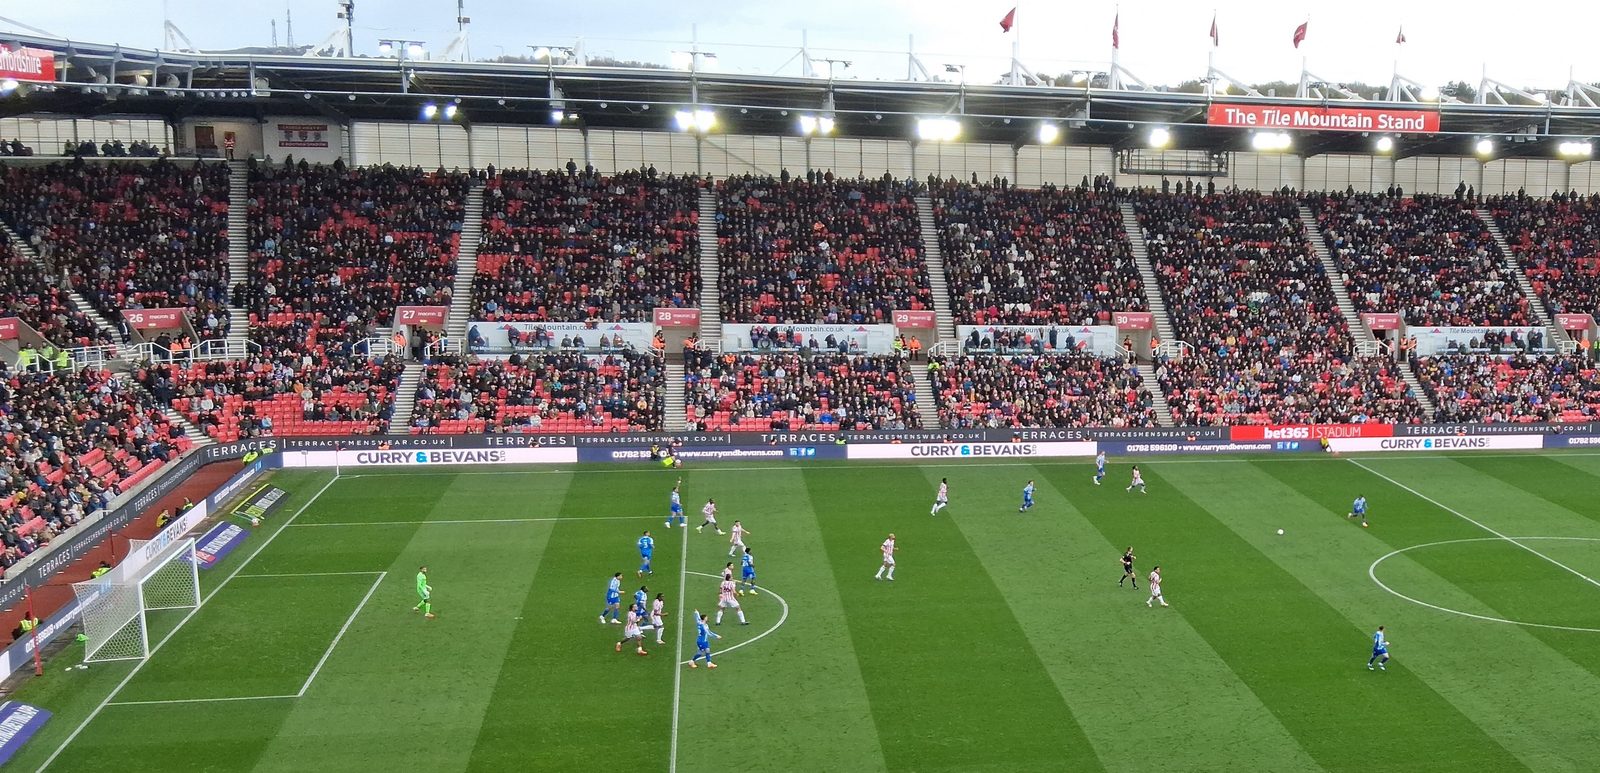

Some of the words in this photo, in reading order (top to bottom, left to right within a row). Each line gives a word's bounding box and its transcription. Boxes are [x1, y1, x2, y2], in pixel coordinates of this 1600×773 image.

[1225, 108, 1257, 124] The
[1262, 109, 1291, 125] Tile
[1294, 110, 1373, 128] Mountain
[1377, 113, 1425, 130] Stand
[129, 313, 144, 323] 26
[402, 310, 416, 319] 27
[659, 311, 672, 321] 28
[897, 314, 909, 323] 29
[1117, 316, 1128, 324] 30
[1367, 316, 1376, 325] 31
[1559, 317, 1568, 325] 32
[1264, 426, 1309, 439] bet365
[1317, 426, 1361, 438] STADIUM
[1407, 425, 1468, 434] TERRACES
[486, 436, 567, 445] TERRACES
[761, 433, 836, 442] TERRACES
[1381, 439, 1422, 449] CURRY
[1424, 438, 1432, 448] &
[1434, 438, 1485, 448] BEVANS
[206, 440, 277, 458] TERRACES
[679, 449, 783, 458] www.curryandbevans.com
[911, 445, 959, 456] CURRY
[961, 445, 970, 455] &
[973, 445, 1032, 455] BEVANS
[357, 451, 414, 464] CURRY
[416, 451, 428, 463] &
[430, 450, 500, 463] BEVANS
[134, 487, 158, 512] TERRACES
[37, 550, 71, 579] TERRACES
